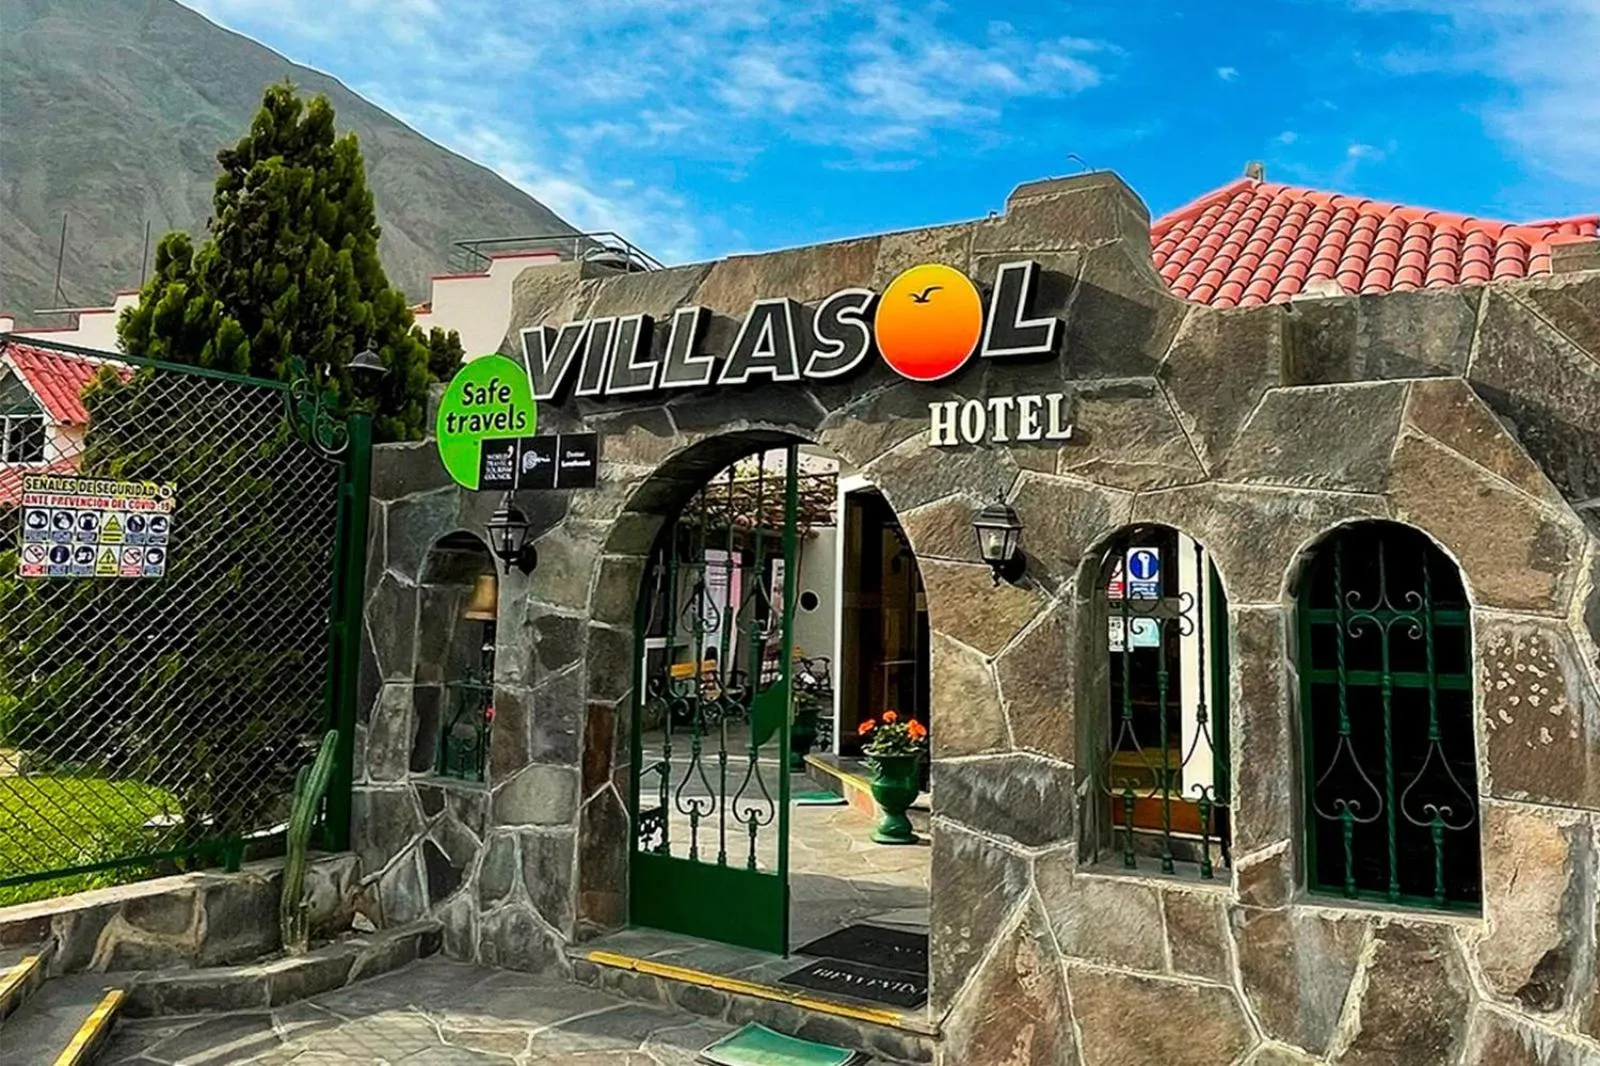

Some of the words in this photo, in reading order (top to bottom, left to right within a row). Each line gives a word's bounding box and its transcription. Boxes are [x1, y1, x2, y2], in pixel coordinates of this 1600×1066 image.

[520, 260, 1058, 400] VILLASOL
[462, 377, 511, 406] Safe
[446, 404, 526, 433] travels
[929, 394, 1073, 446] HOTEL
[24, 475, 76, 493] SEÑALES
[79, 480, 94, 494] DE
[96, 482, 156, 497] SEGURIDAD
[23, 494, 48, 506] ANTE
[111, 498, 127, 509] DEL
